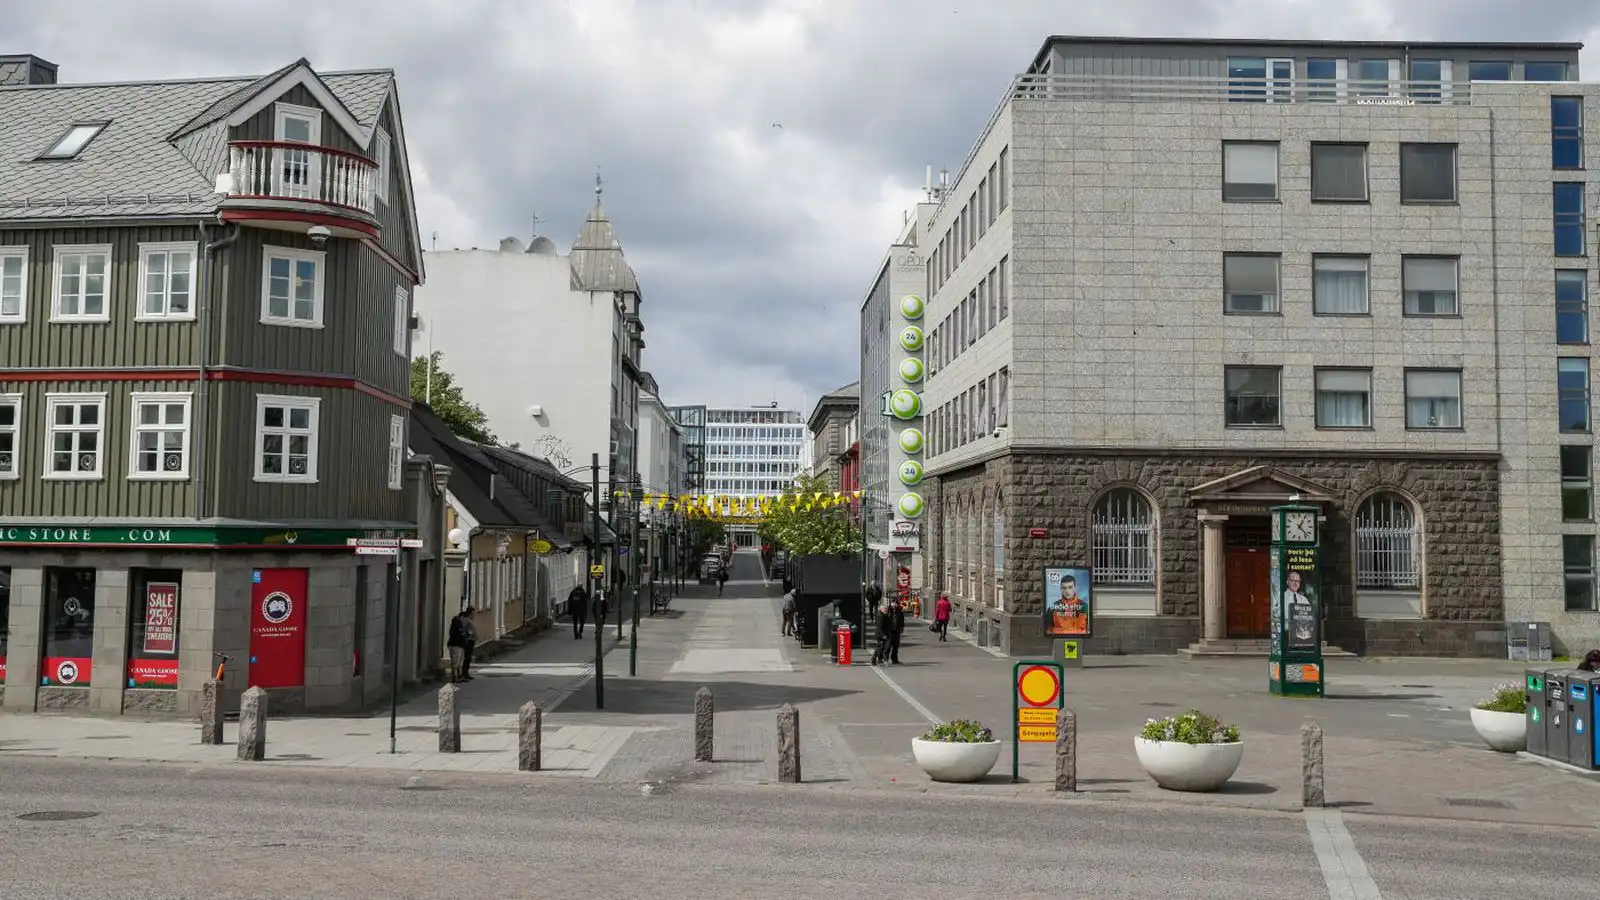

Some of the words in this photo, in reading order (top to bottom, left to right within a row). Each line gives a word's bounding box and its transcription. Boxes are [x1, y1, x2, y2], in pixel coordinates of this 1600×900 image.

[905, 467, 915, 475] 24
[29, 528, 92, 541] STORE
[120, 529, 171, 541] .COM
[892, 529, 919, 537] SBARRO
[149, 592, 174, 608] SALE
[149, 608, 173, 626] 25%
